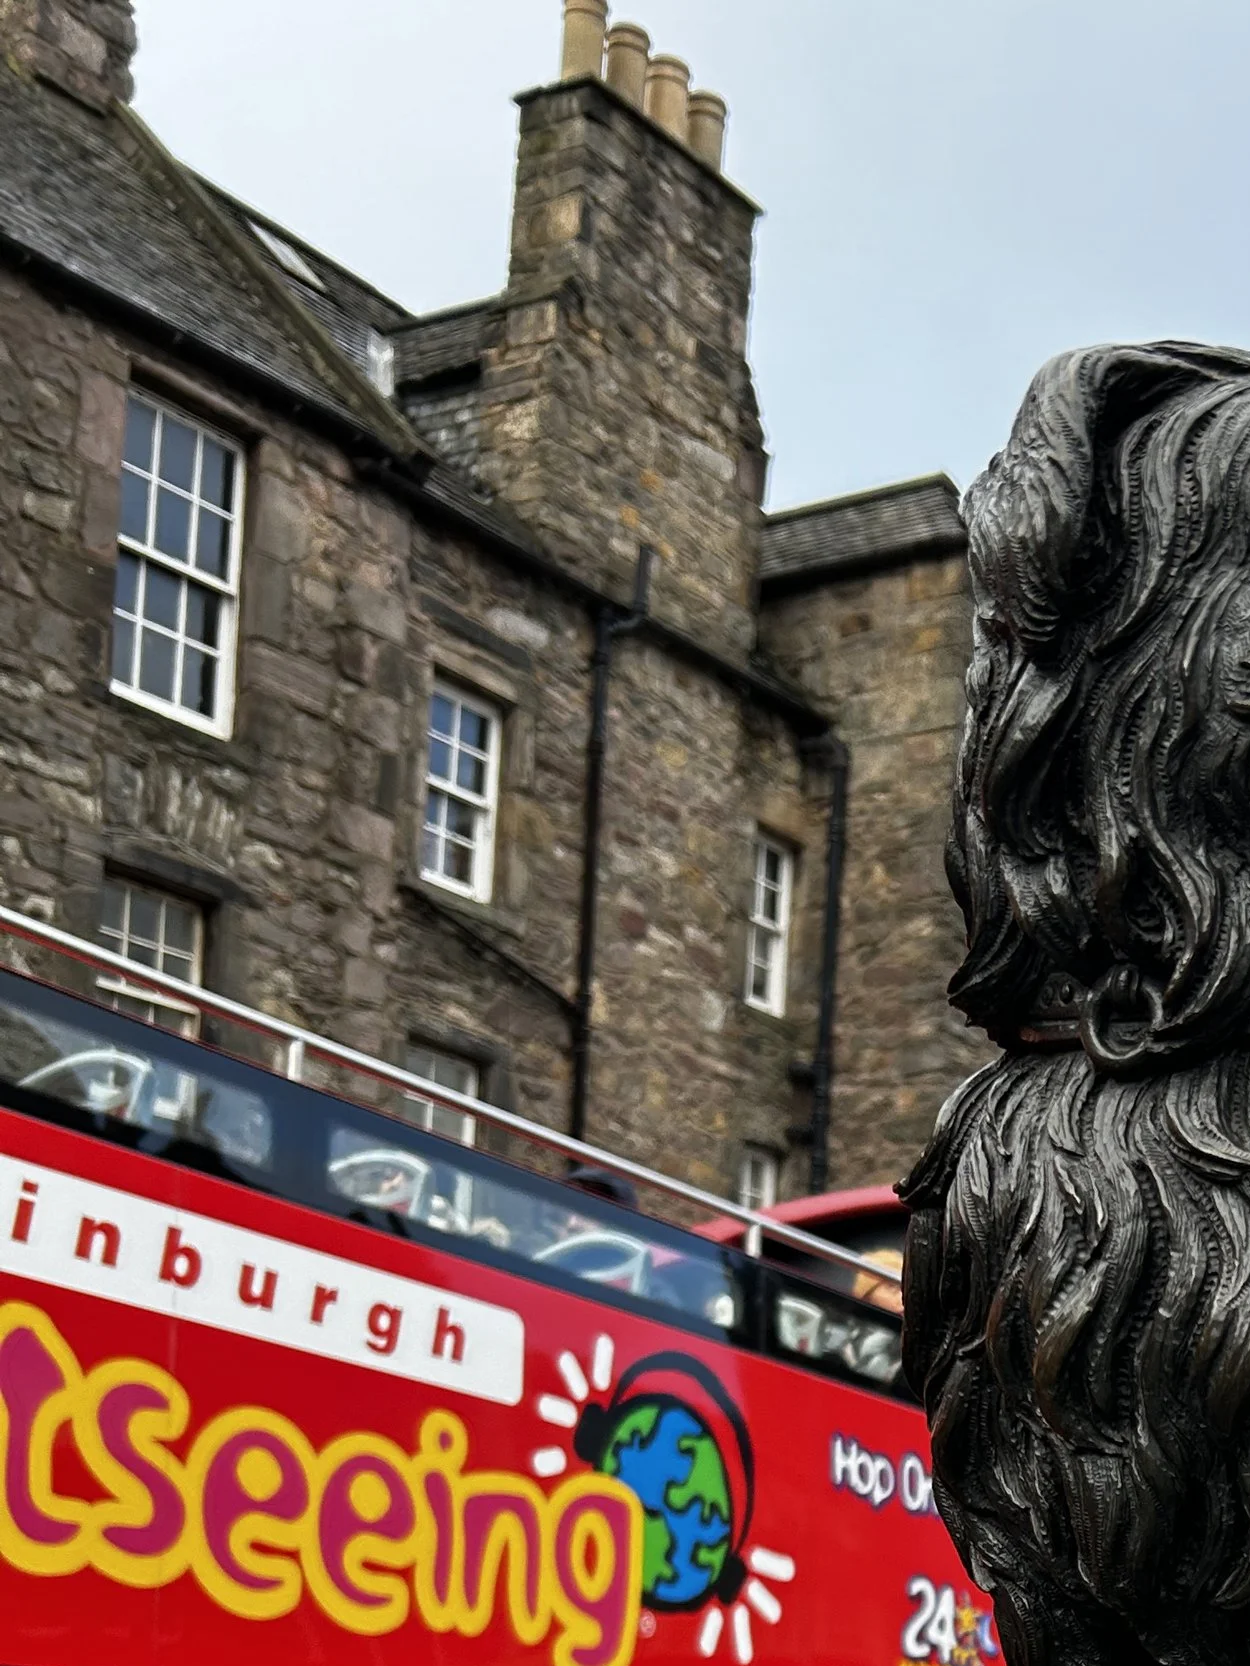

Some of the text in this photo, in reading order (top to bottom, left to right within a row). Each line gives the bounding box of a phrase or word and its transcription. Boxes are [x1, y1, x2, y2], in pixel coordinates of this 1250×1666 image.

[10, 1180, 467, 1363] inburgh
[830, 1434, 895, 1508] Hop
[904, 1575, 957, 1664] 24
